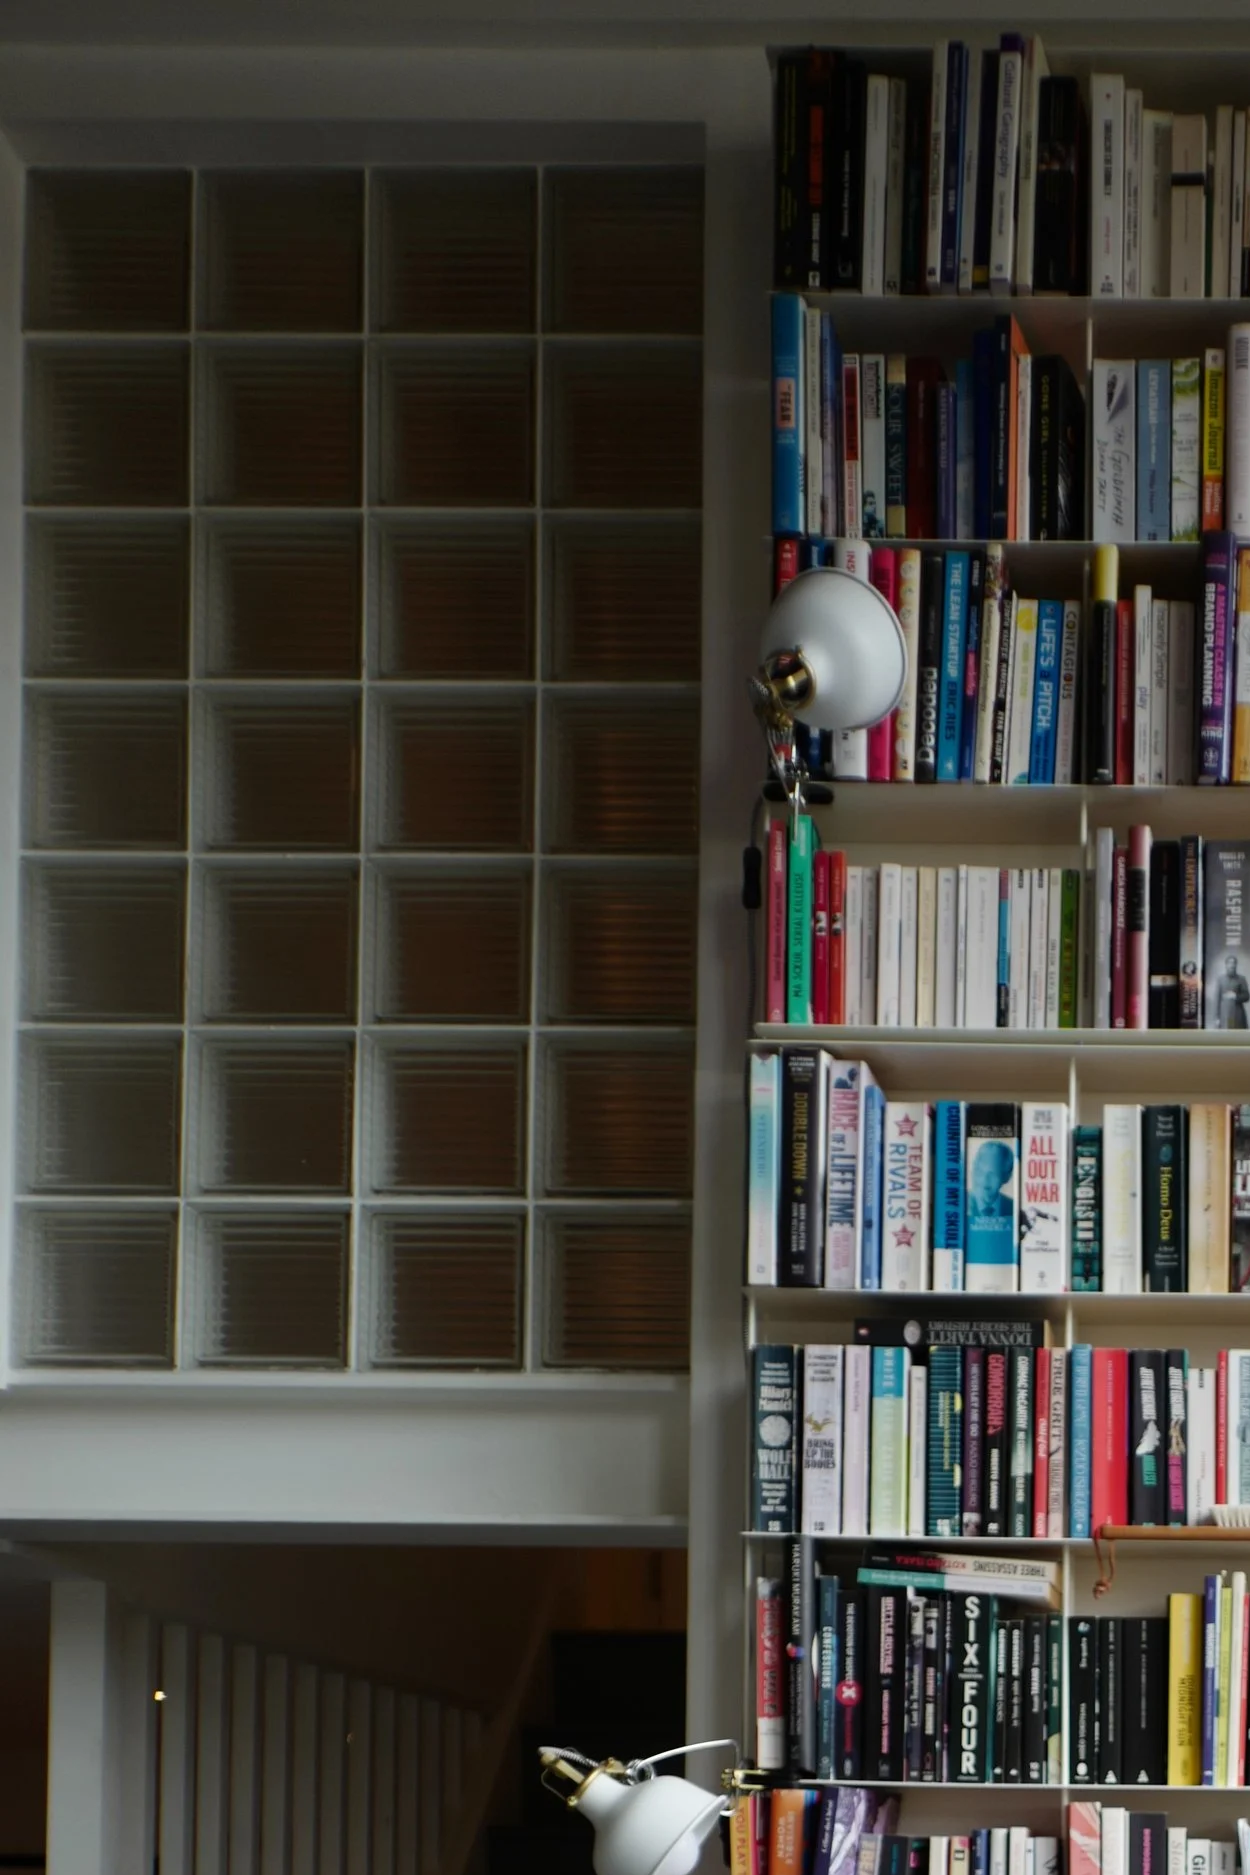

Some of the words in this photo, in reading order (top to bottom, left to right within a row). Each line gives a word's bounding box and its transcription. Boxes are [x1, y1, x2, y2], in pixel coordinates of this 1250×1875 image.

[1000, 60, 1016, 109] Cultural
[997, 112, 1013, 178] Geography
[887, 385, 904, 436] SOUR
[887, 443, 905, 504] SWEET
[950, 562, 962, 582] THE
[948, 584, 961, 617] LEAN
[1202, 583, 1215, 626] BRAND
[947, 619, 960, 677] STARTUP
[1038, 618, 1056, 667] LIFE'S
[1061, 611, 1077, 700] CONTAGIOUS
[1201, 630, 1215, 706] PLANNING
[917, 666, 938, 764] Decoded
[946, 681, 958, 710] ERIC
[945, 713, 957, 741] RIES
[1224, 879, 1243, 947] RASPUTIN
[832, 1090, 857, 1132] RACE
[945, 1106, 960, 1164] COUNTRY
[1028, 1135, 1058, 1156] ALL
[887, 1143, 906, 1220] RIVALS
[906, 1143, 922, 1193] TEAM
[946, 1167, 959, 1184] OF
[1027, 1159, 1058, 1179] OUT
[1159, 1166, 1172, 1204] Homo
[830, 1155, 854, 1228] LIFETIME
[907, 1198, 922, 1222] OF
[946, 1188, 959, 1205] MY
[1026, 1182, 1060, 1203] WAR
[945, 1208, 958, 1249] SKULL
[1158, 1207, 1172, 1240] Deus
[1051, 1355, 1062, 1395] TRUE
[1050, 1400, 1062, 1442] GRIT
[961, 1597, 982, 1667] SIX
[959, 1679, 980, 1775] FOUR
